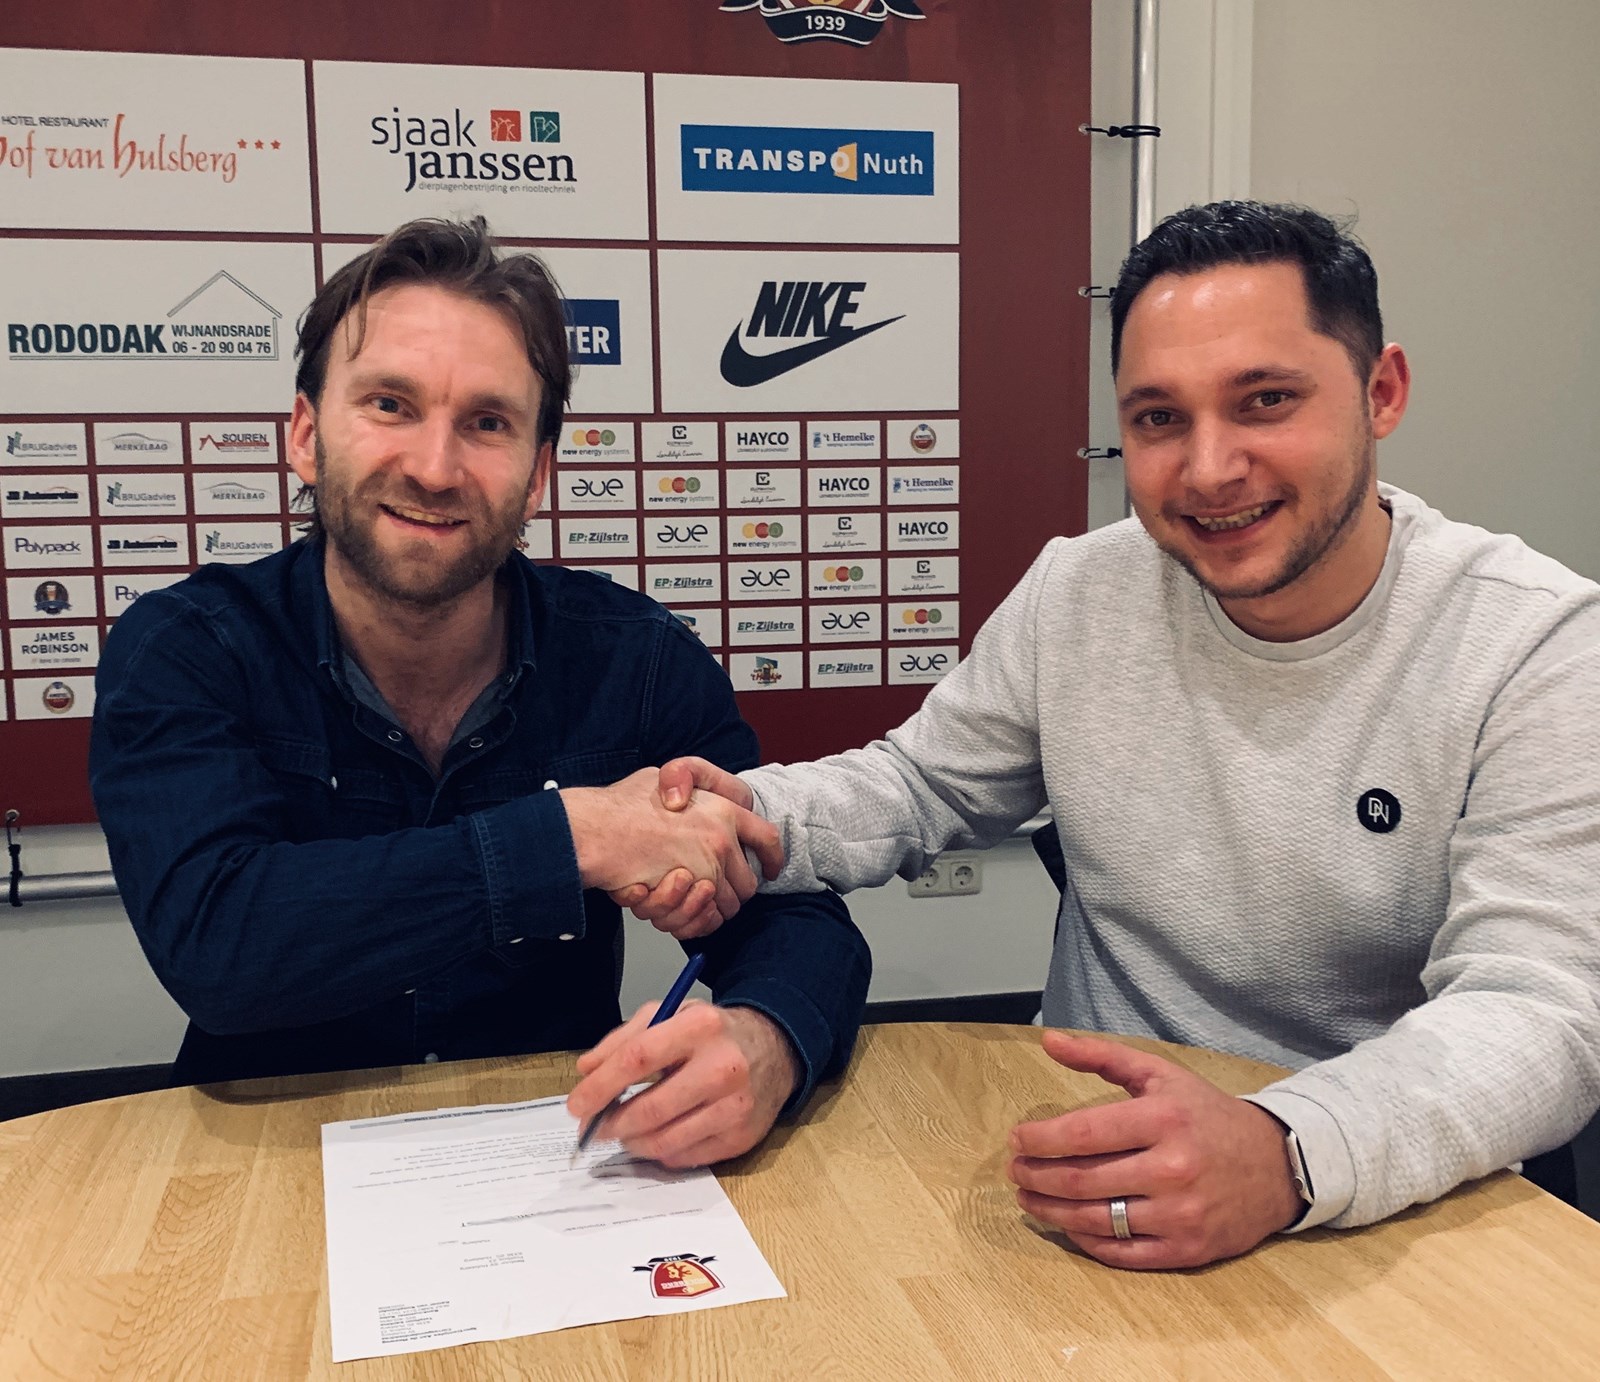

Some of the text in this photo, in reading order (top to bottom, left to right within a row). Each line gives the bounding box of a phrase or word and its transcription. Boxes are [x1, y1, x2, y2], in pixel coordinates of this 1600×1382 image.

[805, 15, 846, 31] 1939
[1, 116, 109, 128] HOTEL RESTAURANT
[371, 107, 477, 154] sjaak
[45, 148, 105, 169] van
[693, 147, 924, 175] TRANSPO Nuth
[404, 151, 578, 193] janssen
[510, 185, 521, 193] en
[746, 281, 867, 338] NIKE
[171, 324, 271, 338] WIJNANDSRADE
[8, 323, 167, 354] RODODAK
[172, 341, 188, 353] 06
[201, 341, 216, 353] 20
[219, 341, 234, 353] 90
[238, 341, 252, 353] 04
[256, 342, 271, 354] 76
[222, 433, 267, 443] SOUREN
[737, 432, 789, 446] HAYCO
[833, 432, 875, 442] Hemelke
[114, 443, 168, 451] MERKELBAG
[819, 477, 870, 491] HAYCO
[912, 477, 954, 487] Hemelke
[212, 492, 265, 500] MERKELBAG
[665, 496, 687, 504] energy
[899, 521, 948, 536] HAYCO
[588, 532, 629, 543] Zijlstra
[748, 541, 770, 549] energy
[673, 577, 713, 588] Zijlstra
[756, 621, 795, 632] Zijlstra
[34, 632, 75, 643] JAMES
[22, 643, 89, 655] ROBINSON
[836, 662, 874, 674] Zijlstra
